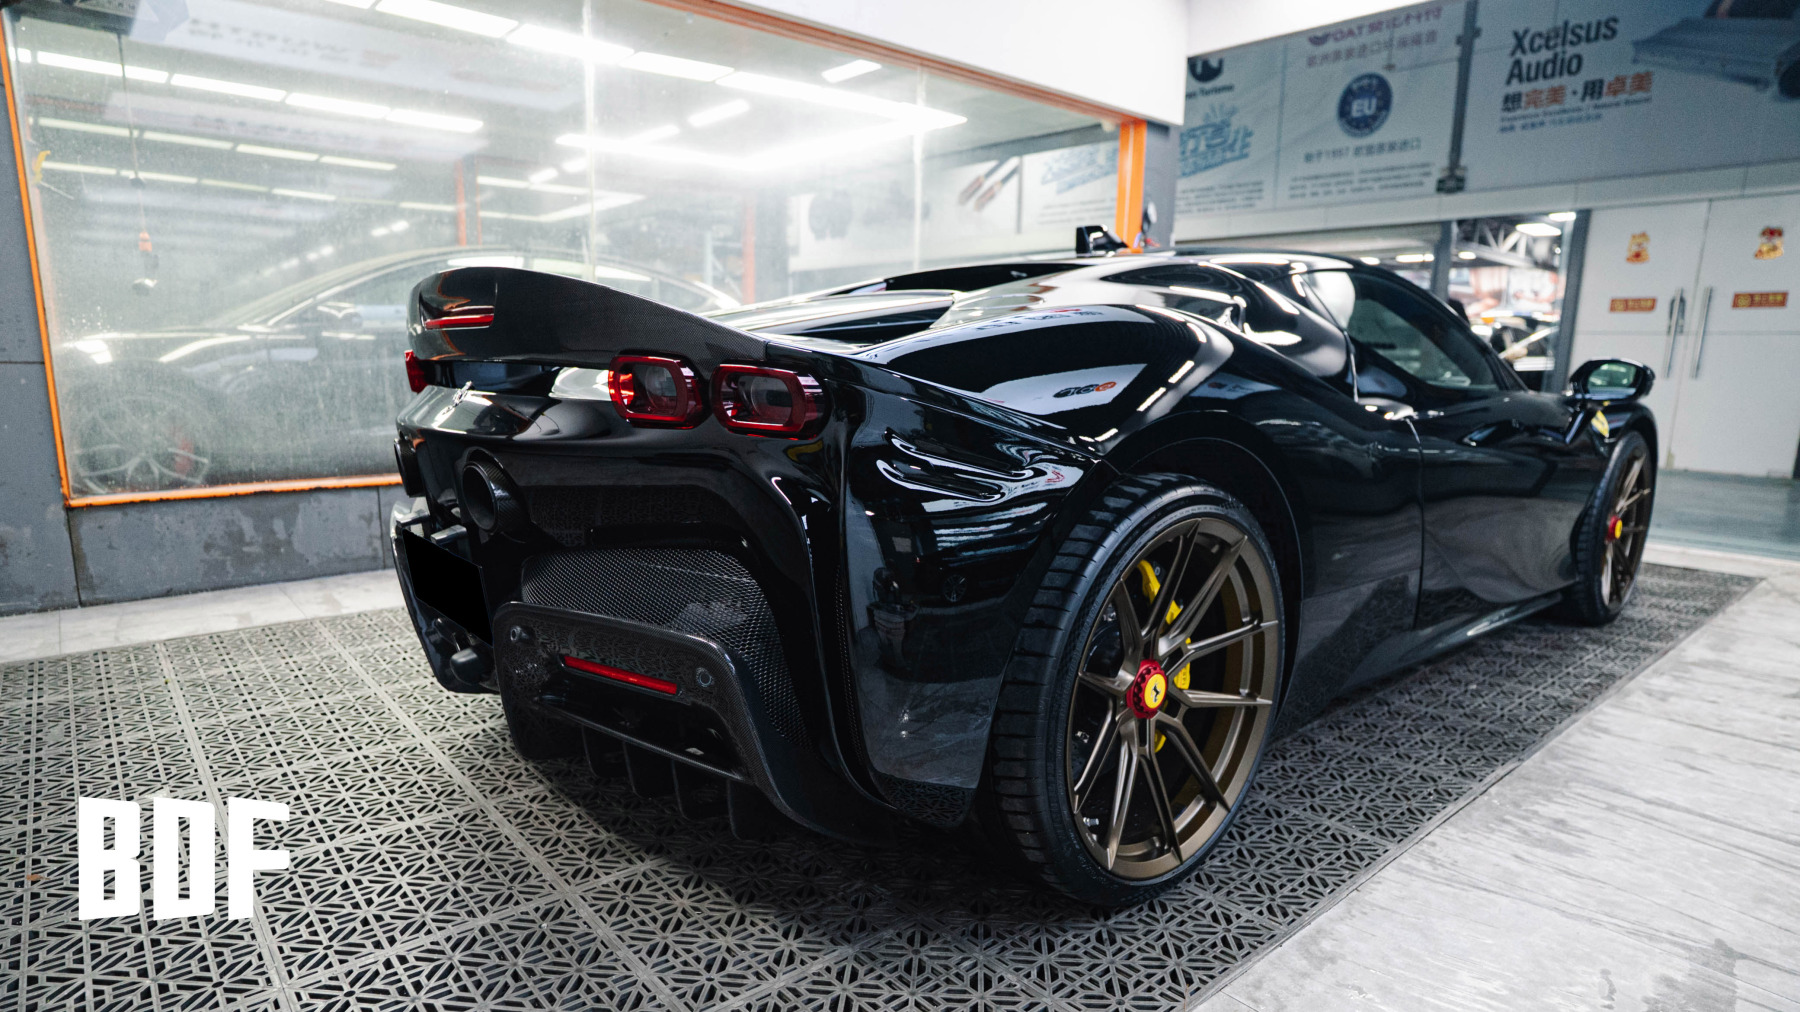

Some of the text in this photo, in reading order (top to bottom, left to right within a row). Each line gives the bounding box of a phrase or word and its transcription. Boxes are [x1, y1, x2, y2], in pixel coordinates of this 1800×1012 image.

[1510, 17, 1620, 57] Xcelsus
[1506, 50, 1584, 86] Audio
[1351, 97, 1378, 118] EU
